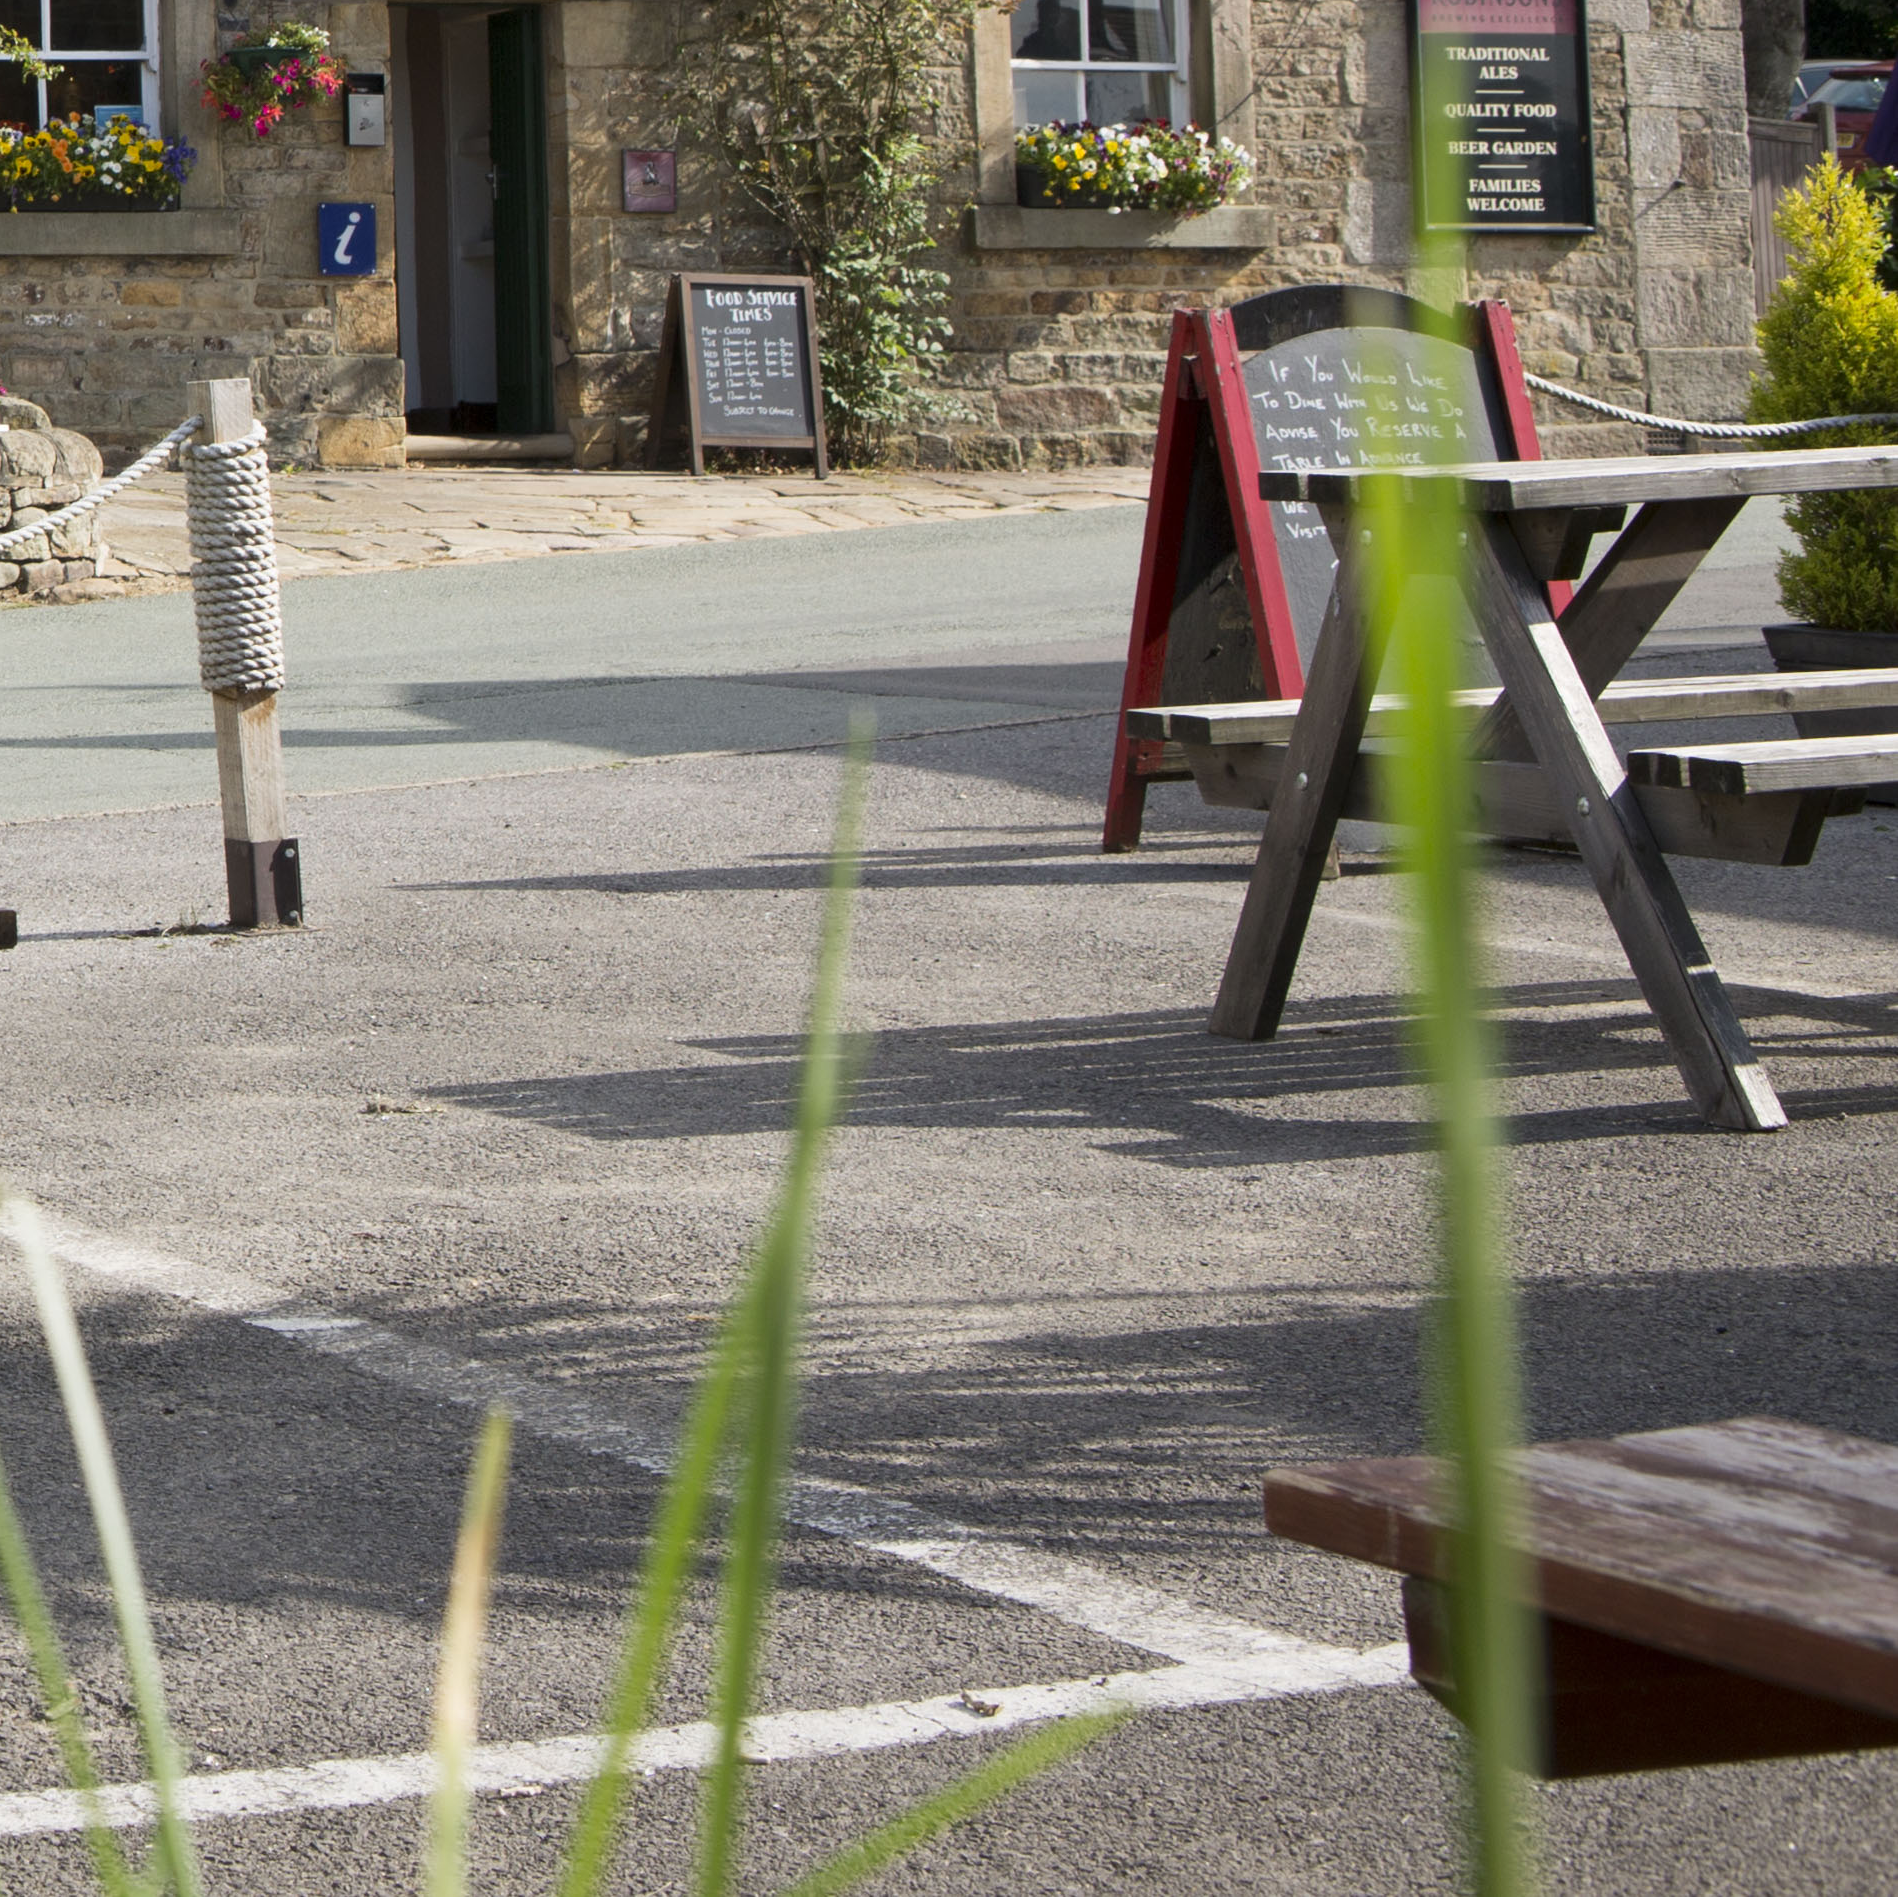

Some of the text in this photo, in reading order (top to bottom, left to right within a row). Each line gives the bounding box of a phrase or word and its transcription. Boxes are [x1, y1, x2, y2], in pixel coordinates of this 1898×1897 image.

[1446, 47, 1550, 61] TRADITIONAL
[1479, 66, 1518, 79] ALES
[1445, 104, 1557, 118] QUALITY FOOD
[1448, 141, 1557, 155] BEER GARDEN
[1469, 179, 1541, 193] FAMILIES
[1466, 198, 1545, 212] WELCOME
[706, 289, 797, 308] FOOD SERVICE
[729, 308, 773, 323] TIMES
[1455, 423, 1467, 439] A
